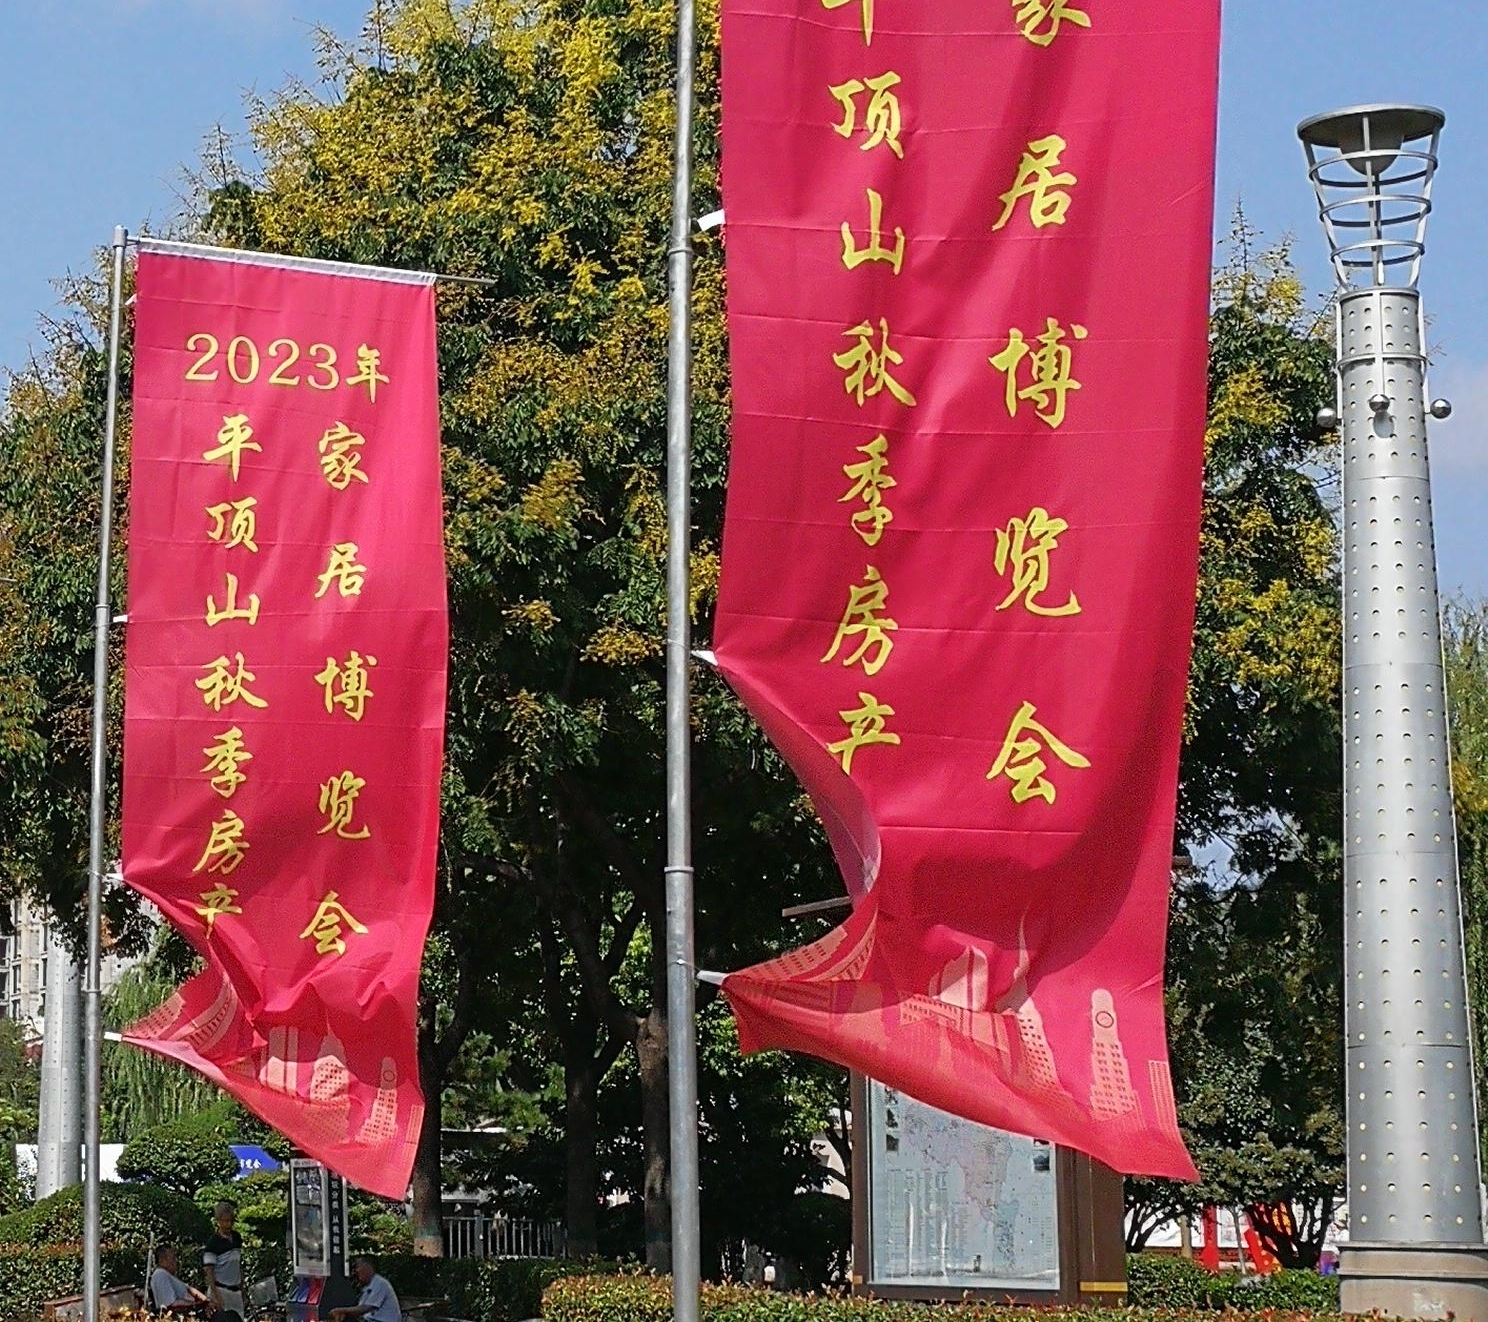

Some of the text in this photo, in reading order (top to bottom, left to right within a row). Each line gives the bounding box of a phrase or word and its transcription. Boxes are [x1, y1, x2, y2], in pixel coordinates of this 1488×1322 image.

[184, 332, 390, 405] 2023年
[192, 412, 269, 939] 平顶山秋季房产
[299, 421, 378, 956] 家居博览会
